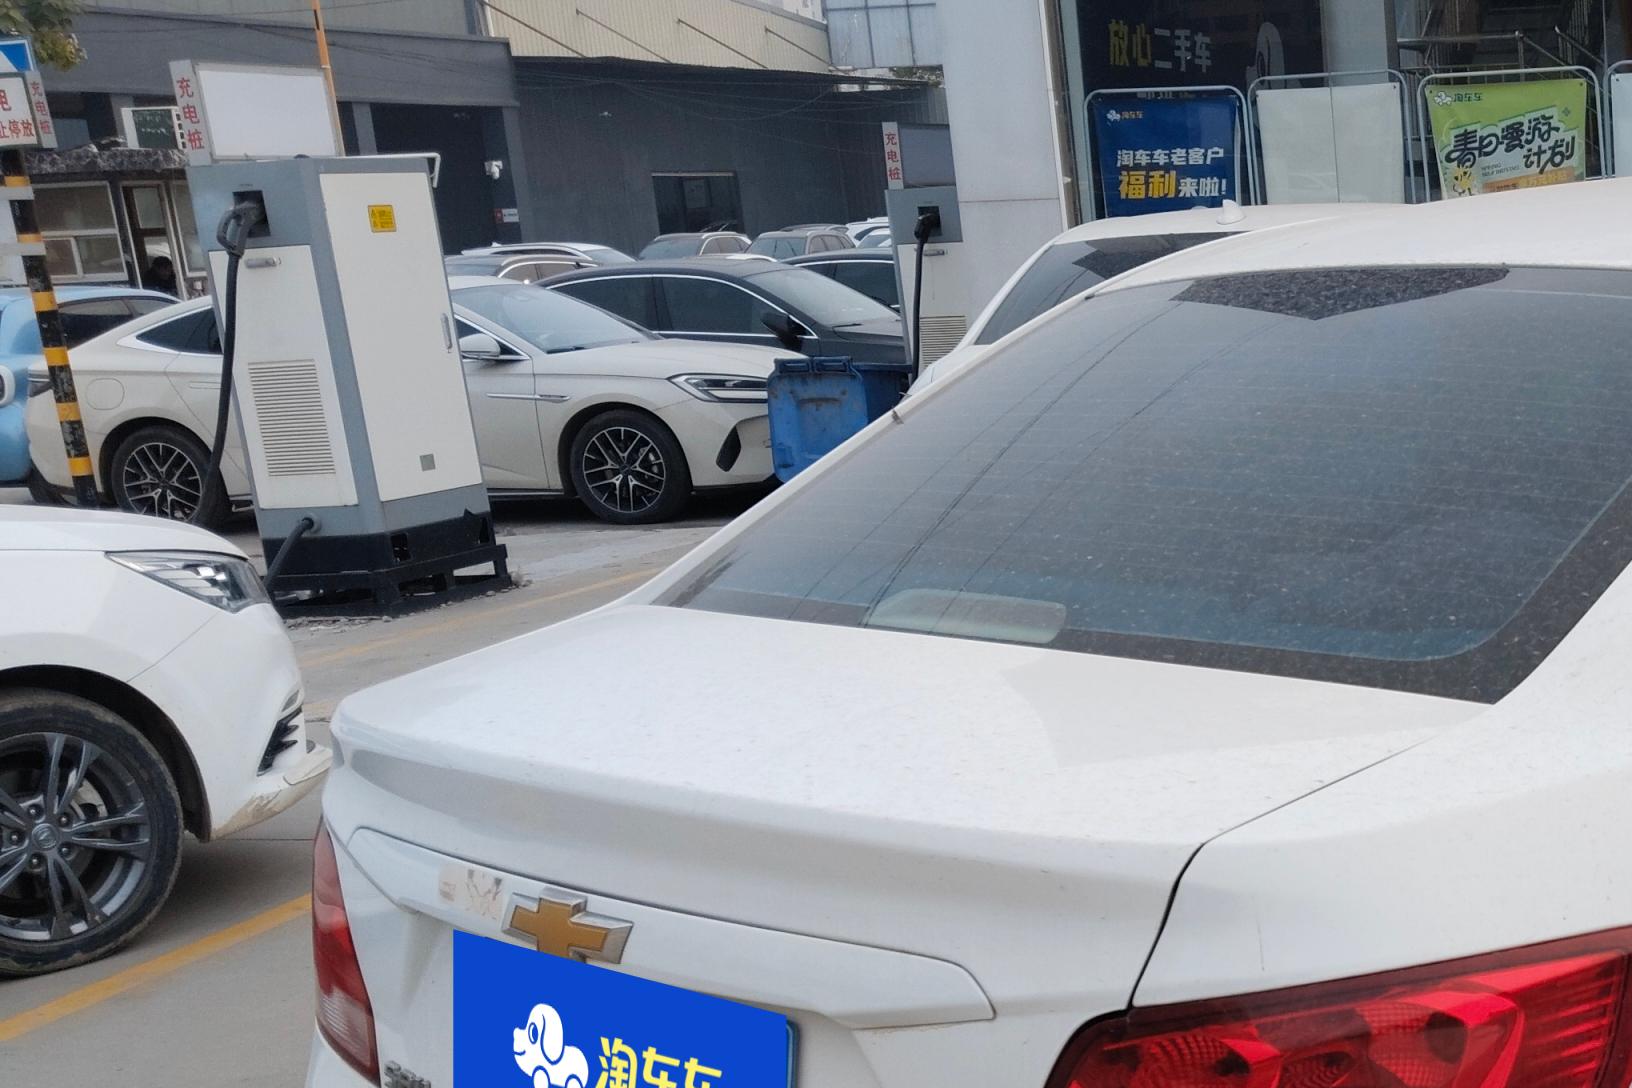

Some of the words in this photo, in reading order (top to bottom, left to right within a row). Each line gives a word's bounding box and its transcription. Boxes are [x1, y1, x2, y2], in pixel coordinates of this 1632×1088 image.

[1108, 19, 1212, 73] 放心二手车
[176, 77, 205, 150] 充电桩
[885, 132, 902, 181] 充电桩
[1116, 147, 1224, 167] 淘车车老客户
[1444, 114, 1561, 169] 春日漫游
[1522, 135, 1576, 175] 计划
